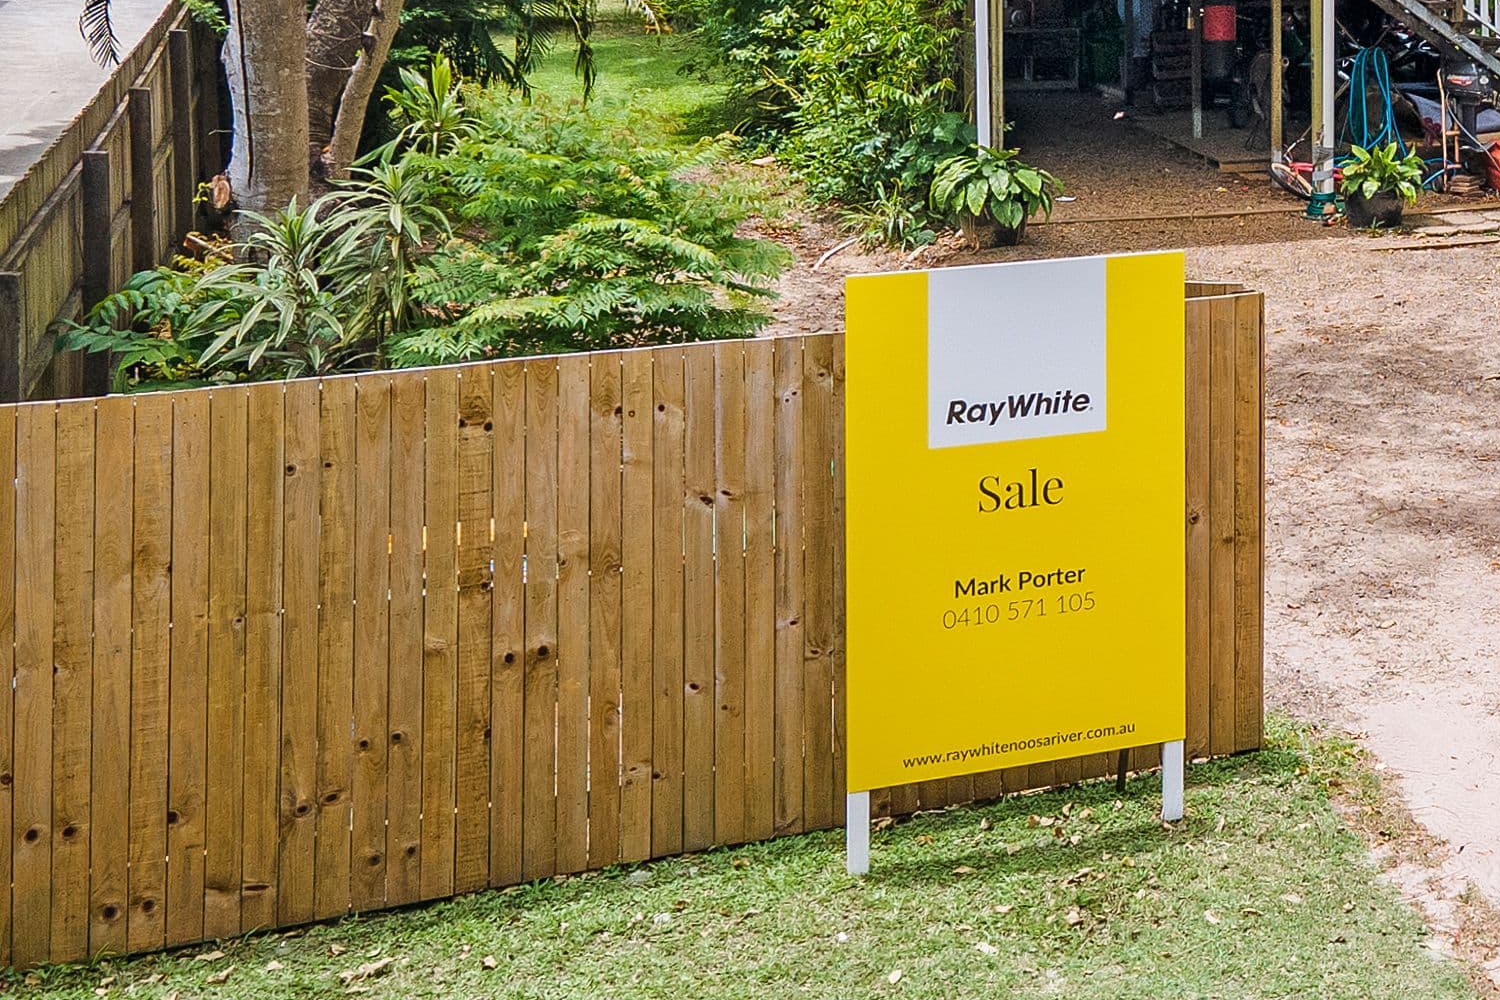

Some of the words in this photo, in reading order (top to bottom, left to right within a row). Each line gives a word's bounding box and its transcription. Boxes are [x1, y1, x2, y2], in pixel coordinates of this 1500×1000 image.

[978, 468, 1064, 513] Sale
[954, 574, 1012, 599] Mark
[1018, 568, 1087, 591] Porter
[942, 604, 1000, 629] 0410
[1007, 598, 1047, 621] 571
[1056, 591, 1096, 614] 105
[902, 722, 1136, 769] www.raywhitenoosariver.com.au
